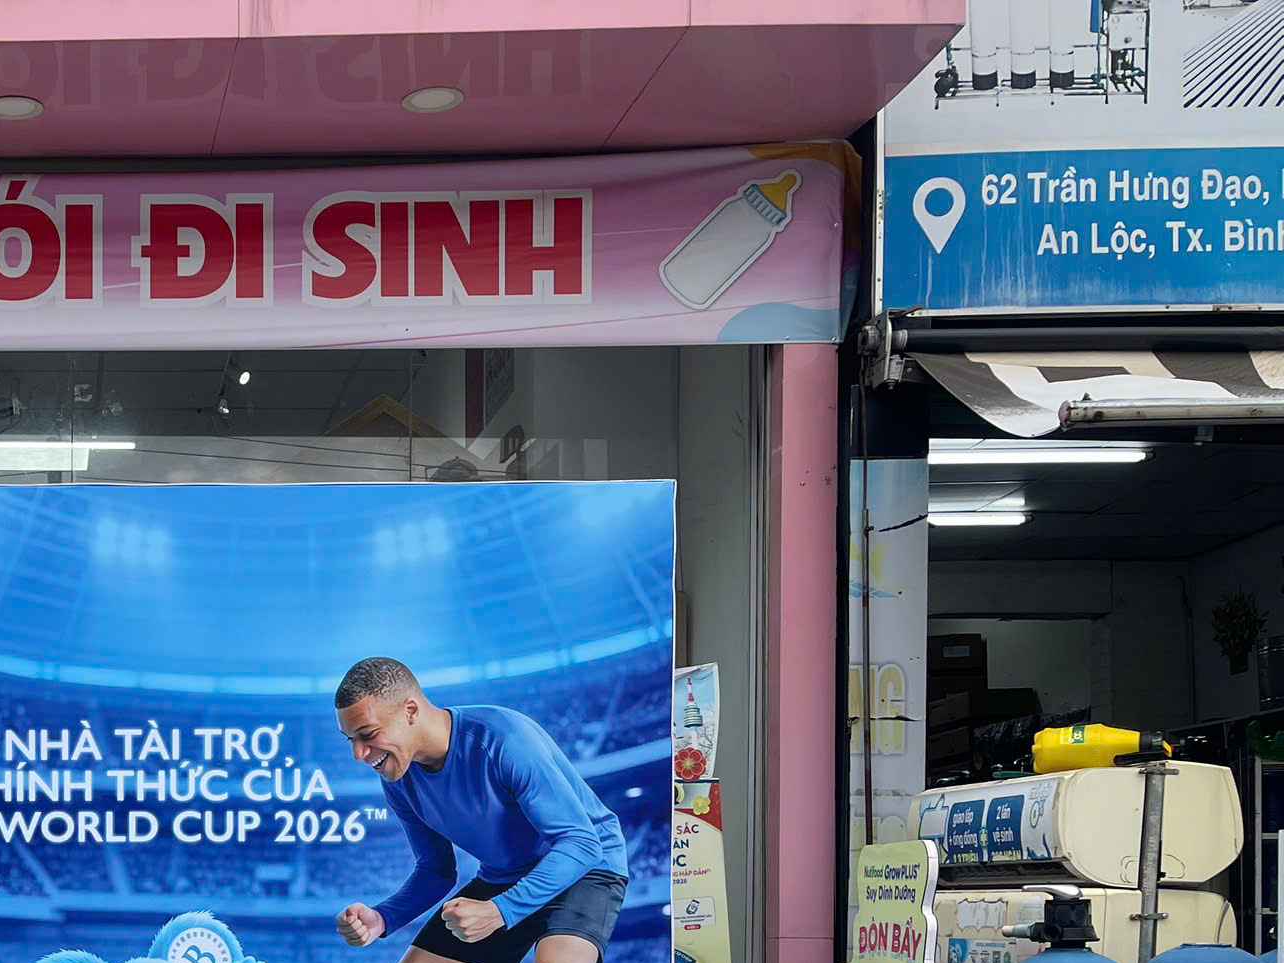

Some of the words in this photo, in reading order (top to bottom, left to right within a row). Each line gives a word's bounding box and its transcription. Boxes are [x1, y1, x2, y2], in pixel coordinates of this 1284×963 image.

[981, 174, 1017, 206] 62
[1028, 165, 1096, 204] Trần
[1109, 170, 1190, 210] Hưng
[1201, 169, 1270, 207] Đạo,
[141, 203, 264, 300] ĐI
[311, 198, 584, 300] SINH
[1037, 224, 1078, 256] An
[1092, 221, 1155, 260] Lộc,
[1166, 221, 1213, 252] Tx.
[5, 720, 100, 761] NHÀ
[115, 720, 180, 761] TÀI
[189, 723, 283, 767] TRỢ
[107, 761, 229, 802] THỨC
[243, 757, 333, 801] CỦA
[173, 811, 260, 842] CUP
[676, 822, 700, 835] SẮC
[996, 806, 1001, 819] 2
[1001, 828, 1014, 842] sinh
[864, 866, 884, 879] Nutifood
[866, 885, 877, 903] Suy
[878, 885, 893, 902] Dinh
[894, 885, 916, 904] Dưỡng
[859, 917, 889, 955] ĐÒN
[891, 916, 922, 961] BẨY
